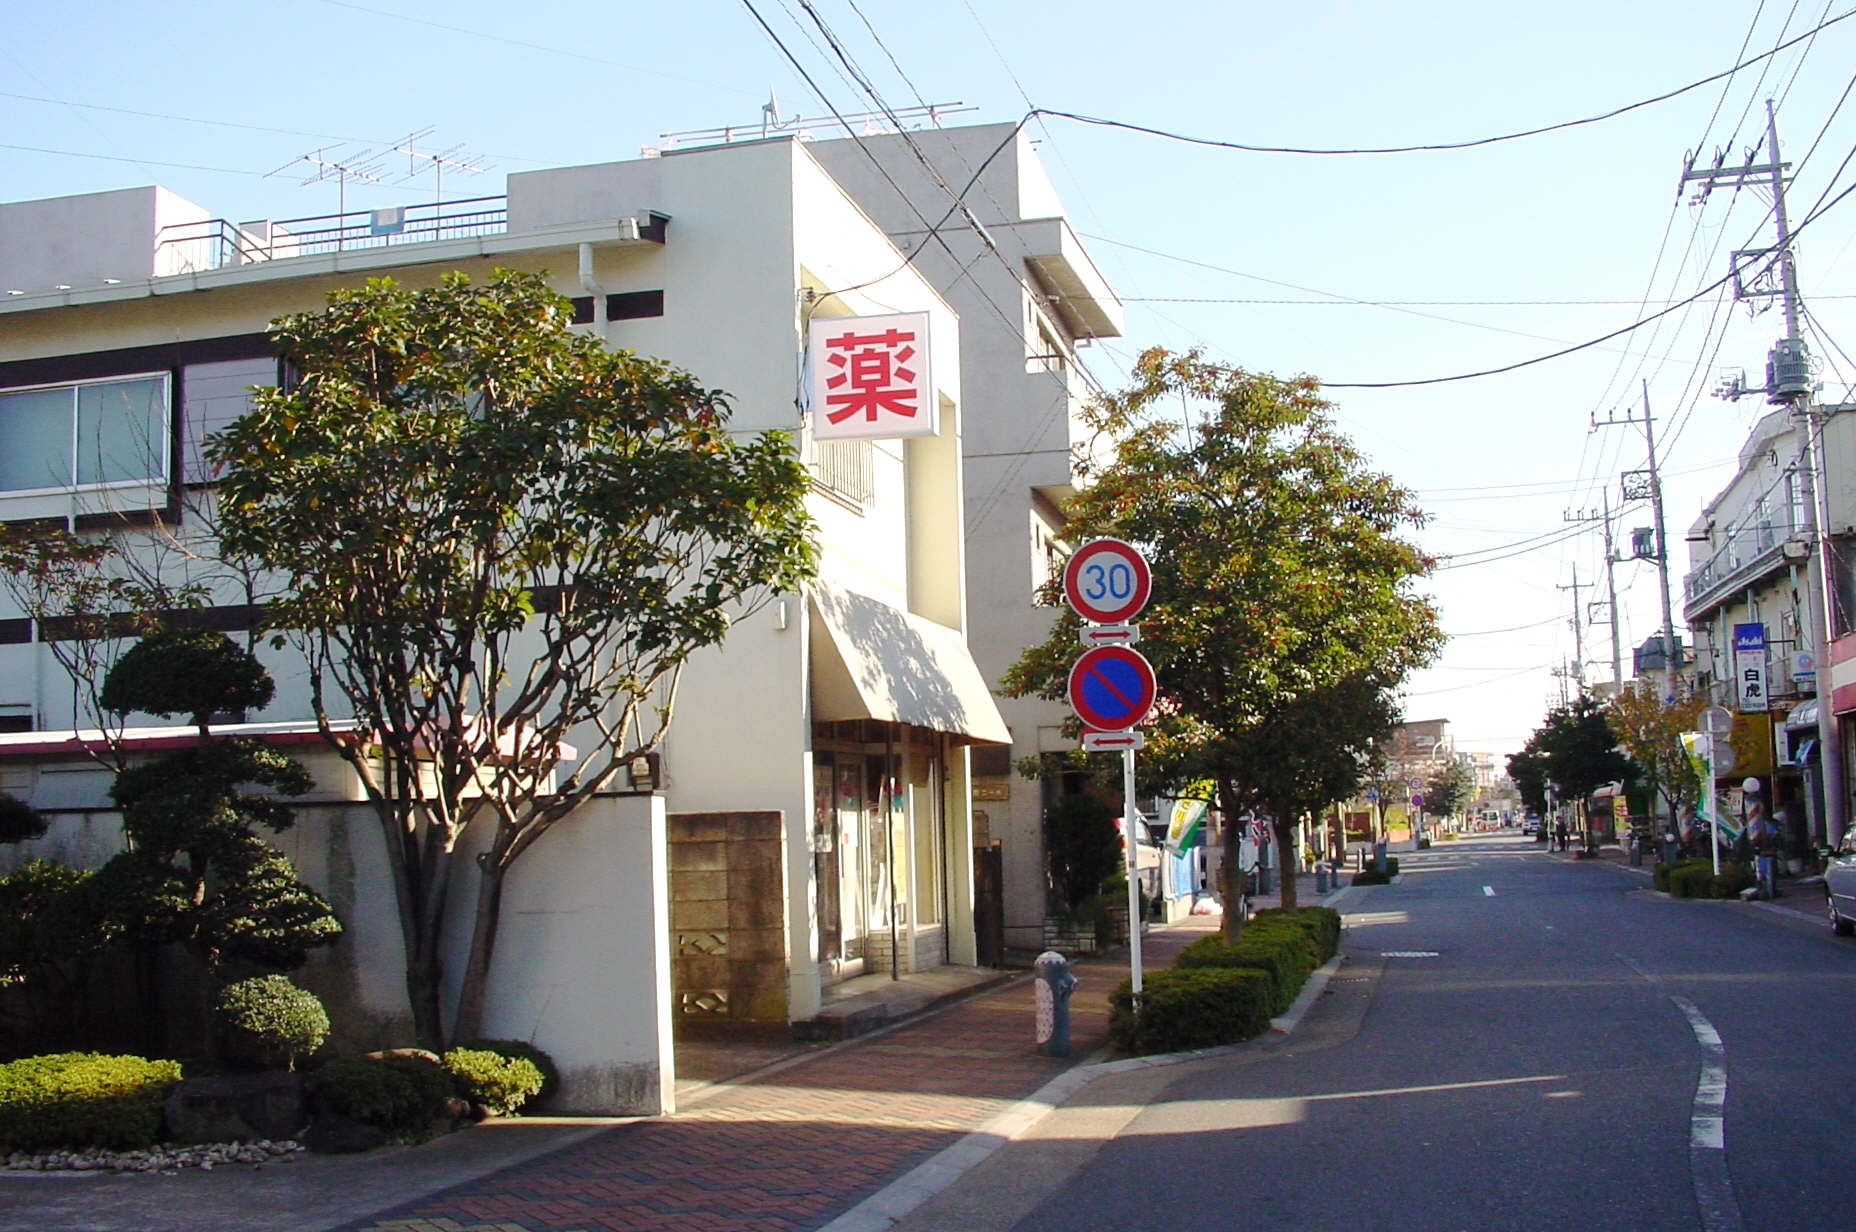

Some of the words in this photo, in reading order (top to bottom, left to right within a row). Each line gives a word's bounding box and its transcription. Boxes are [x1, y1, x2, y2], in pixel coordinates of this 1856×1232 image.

[826, 329, 918, 425] 薬
[1085, 563, 1131, 600] 30
[1737, 635, 1762, 646] Asahi
[1744, 668, 1761, 697] 白虎
